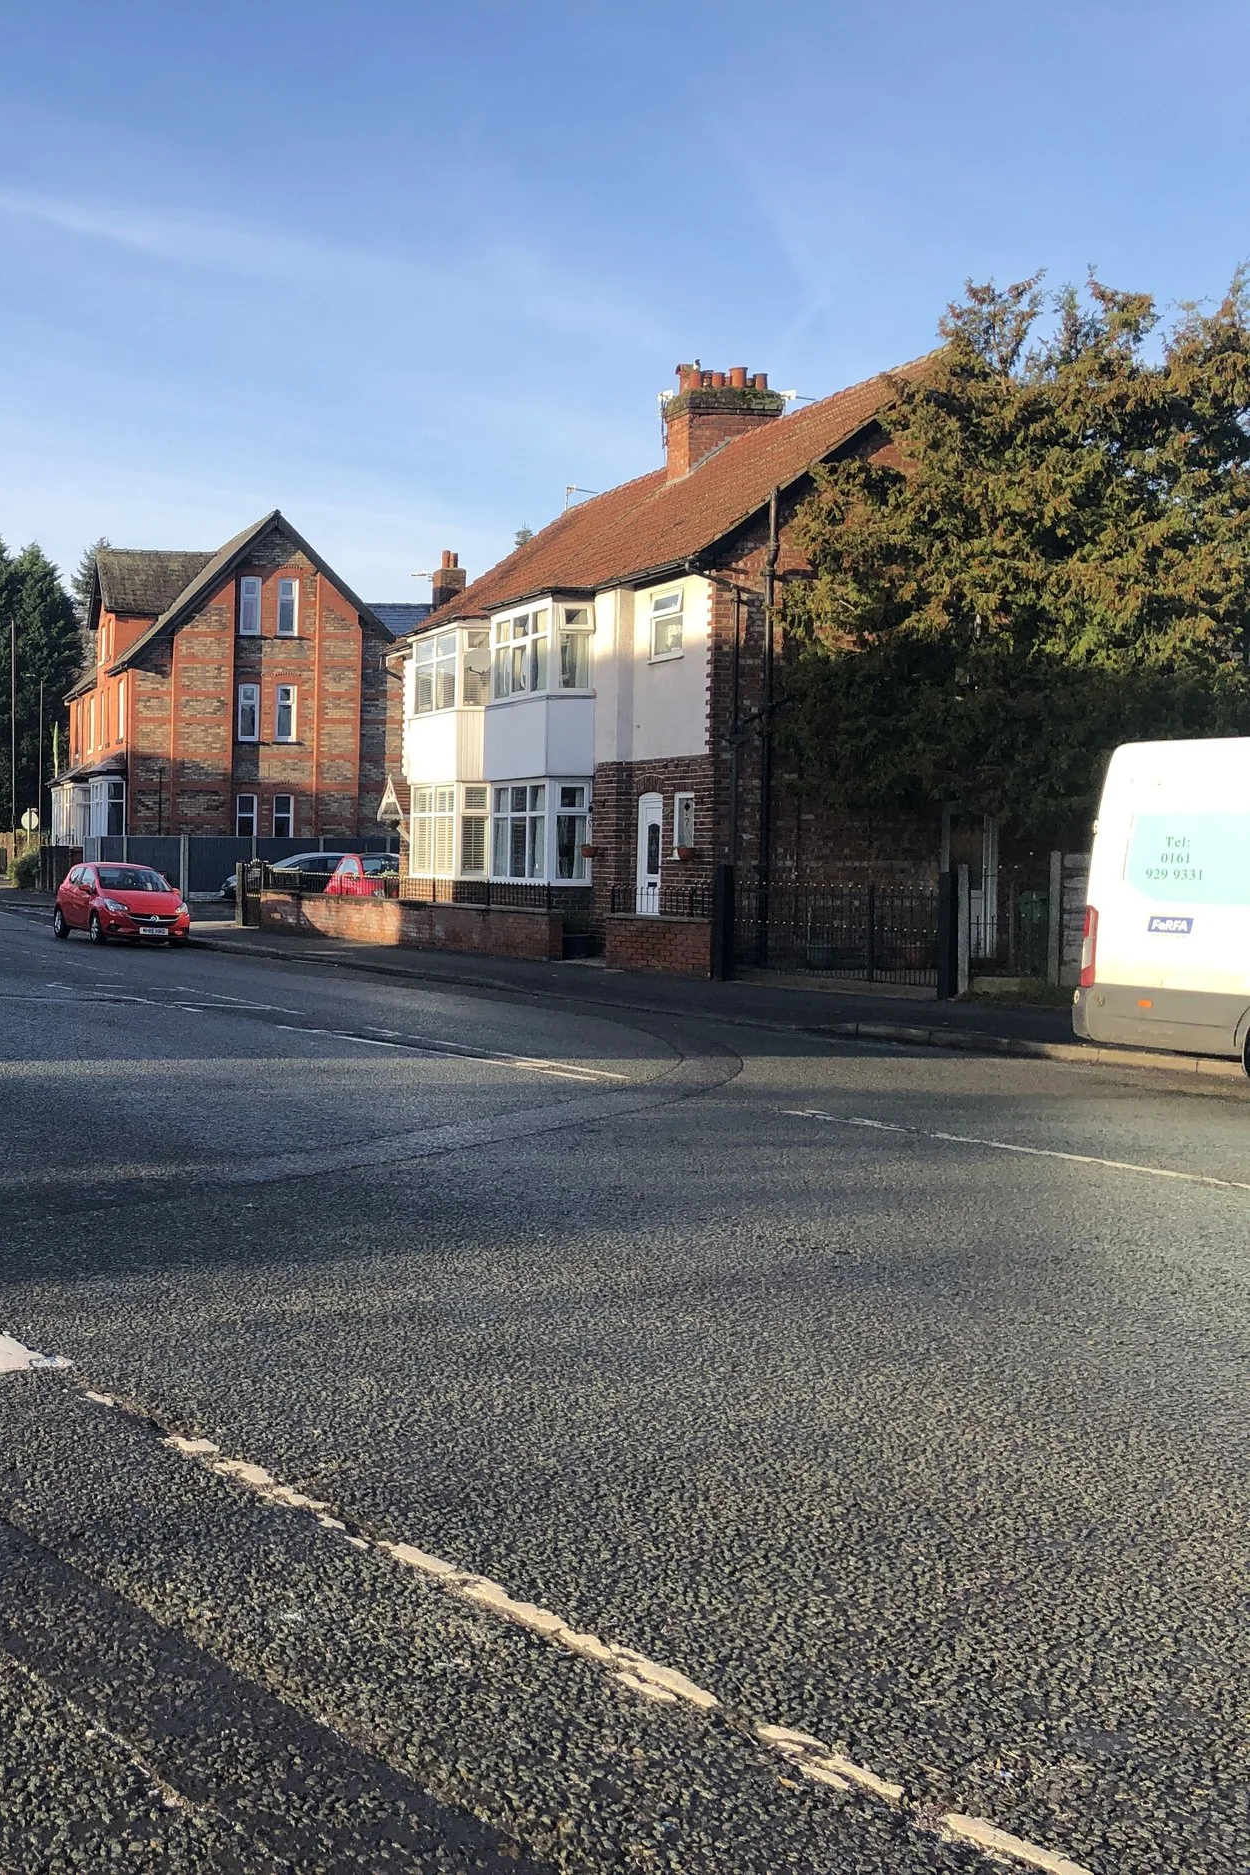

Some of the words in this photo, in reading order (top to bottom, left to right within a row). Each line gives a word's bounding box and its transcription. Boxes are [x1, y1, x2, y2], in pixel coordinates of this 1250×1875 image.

[1165, 836, 1191, 848] Tel:
[1160, 852, 1191, 864] 0161
[1145, 868, 1169, 880] 929
[1173, 869, 1204, 881] 9331
[1150, 918, 1189, 931] FeRFA
